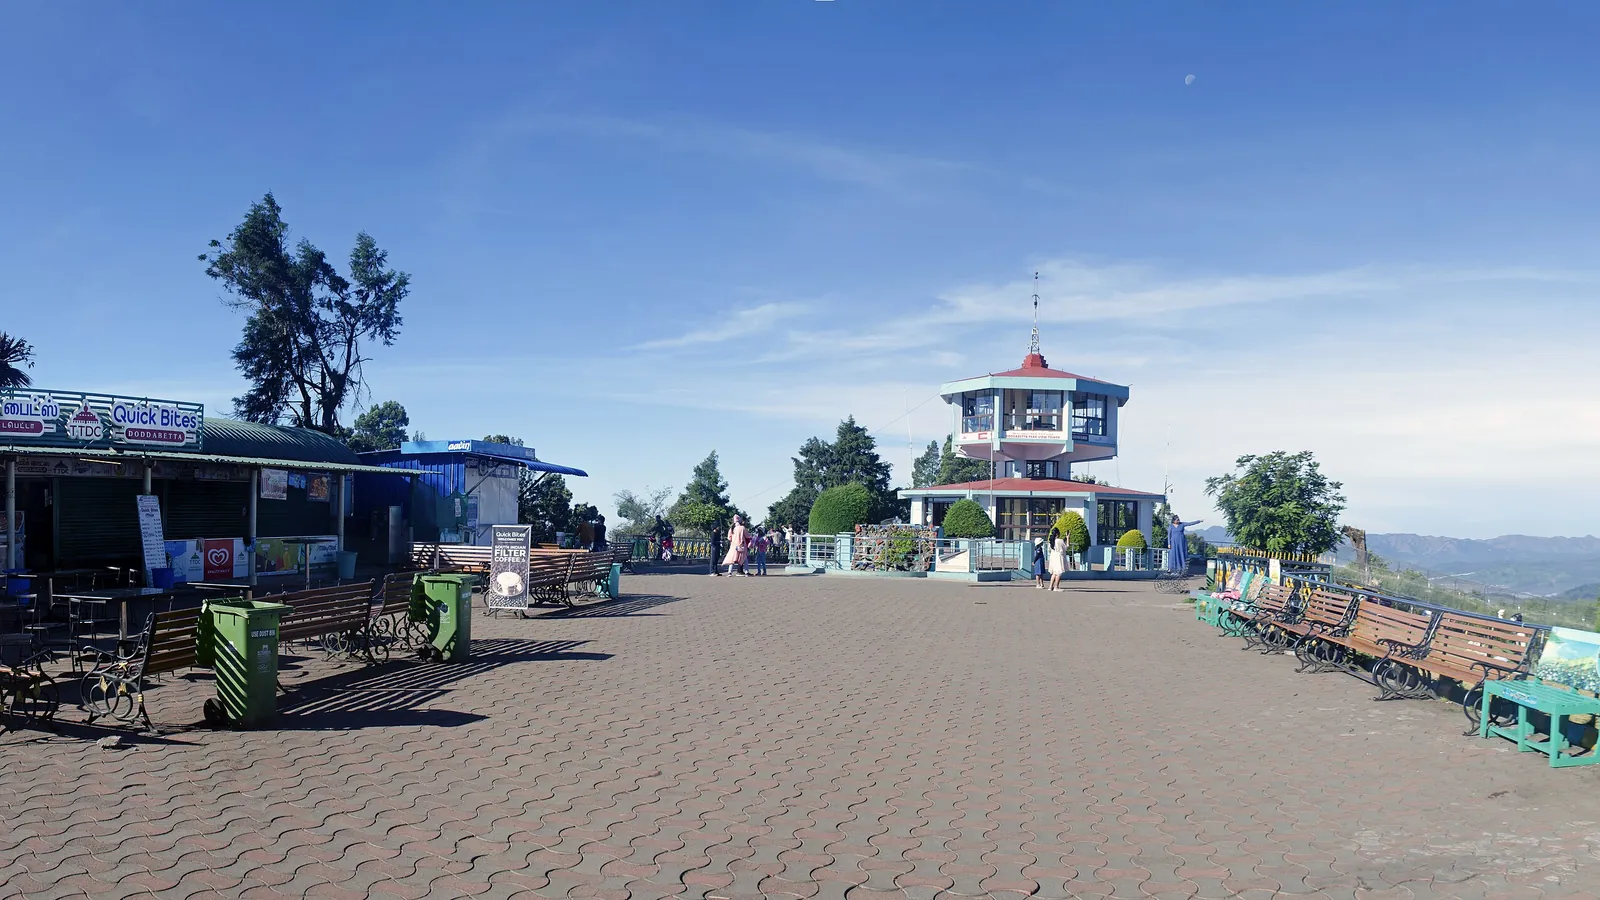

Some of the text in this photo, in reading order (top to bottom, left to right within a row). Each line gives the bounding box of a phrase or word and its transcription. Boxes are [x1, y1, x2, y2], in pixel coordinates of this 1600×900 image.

[4, 398, 58, 417] பைட்ஸ்
[113, 405, 197, 429] Quick Bites
[70, 425, 101, 438] TTDC
[128, 430, 183, 441] DODDABETTA
[494, 549, 526, 557] FILTER
